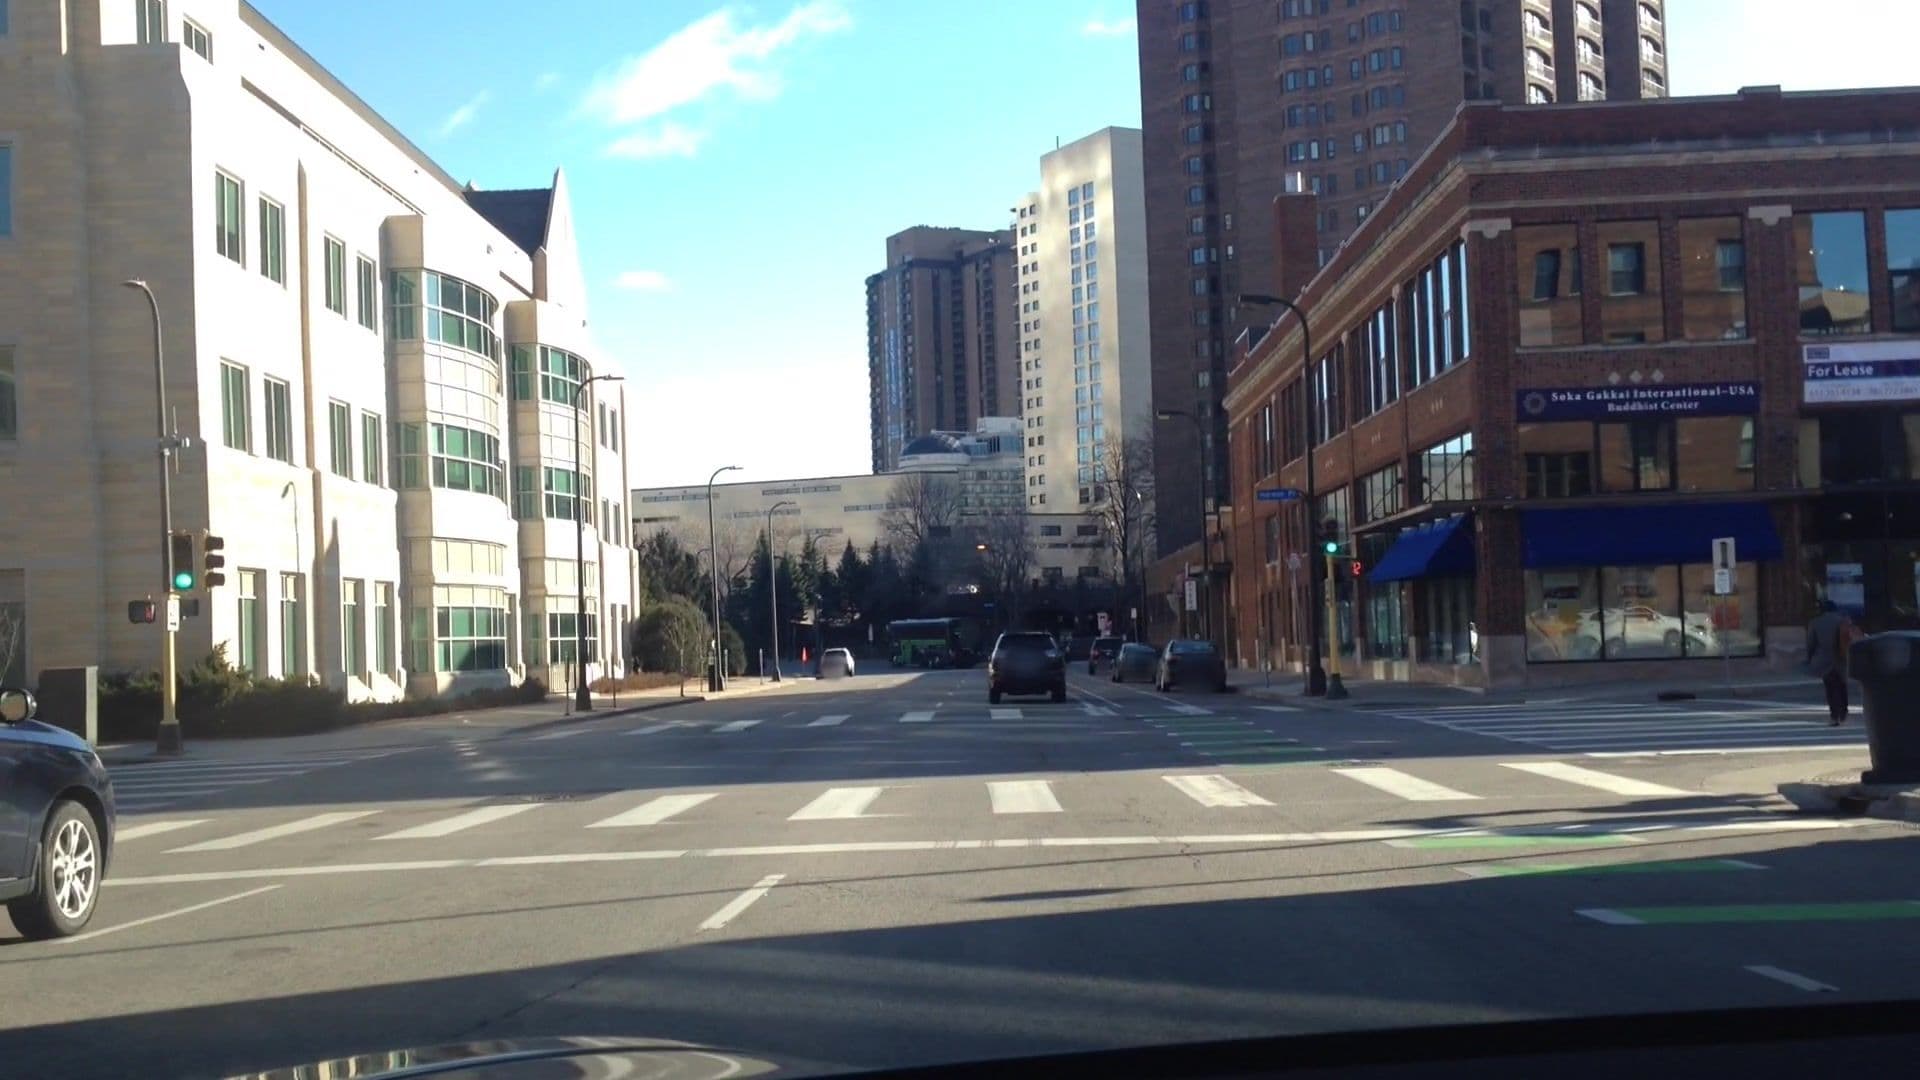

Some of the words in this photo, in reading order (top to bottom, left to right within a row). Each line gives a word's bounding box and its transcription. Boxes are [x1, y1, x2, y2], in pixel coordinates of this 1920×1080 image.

[1808, 365, 1831, 377] For
[1834, 364, 1874, 376] Lease
[1551, 391, 1581, 402] Soka
[1586, 389, 1630, 400] Gakkai
[1607, 401, 1658, 412] Buddhist
[1660, 400, 1699, 410] Center
